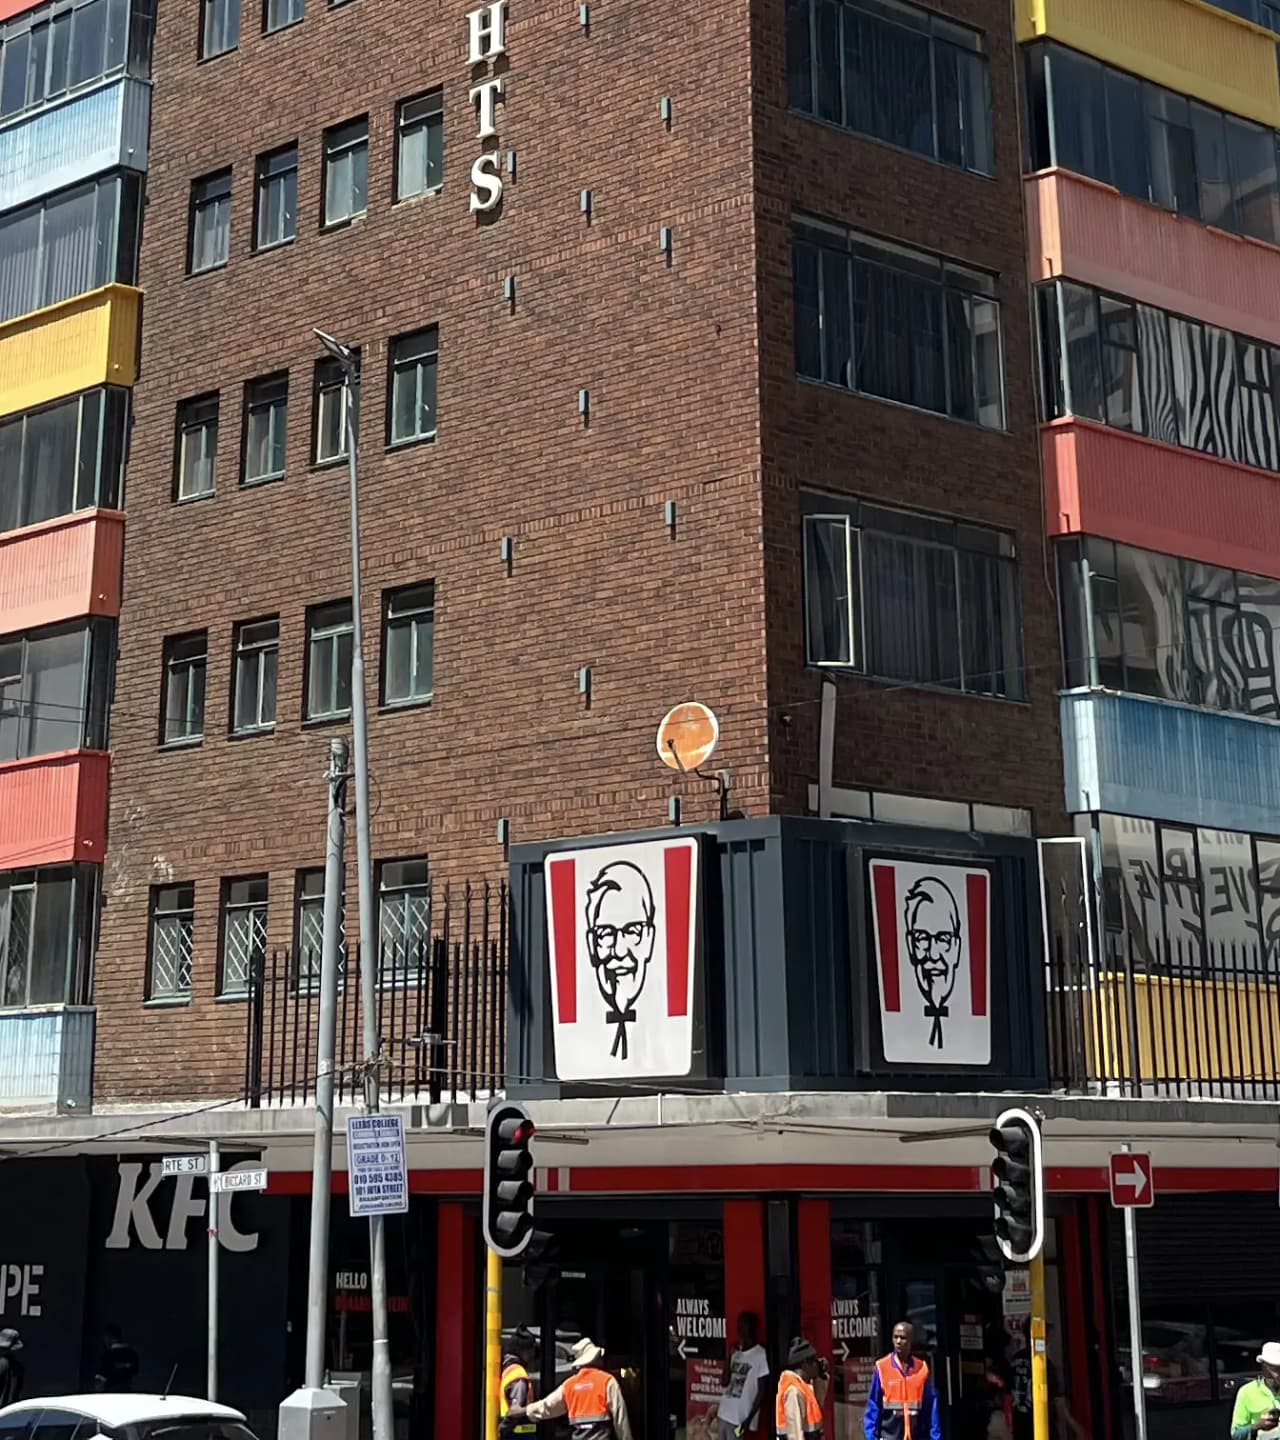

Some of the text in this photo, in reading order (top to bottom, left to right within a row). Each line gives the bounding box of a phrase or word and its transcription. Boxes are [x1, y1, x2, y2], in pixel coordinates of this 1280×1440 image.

[188, 1158, 200, 1170] ST
[382, 1184, 403, 1193] STREET
[105, 1160, 262, 1252] KFC
[336, 1271, 368, 1290] HELLO
[676, 1298, 710, 1315] ALWAYS
